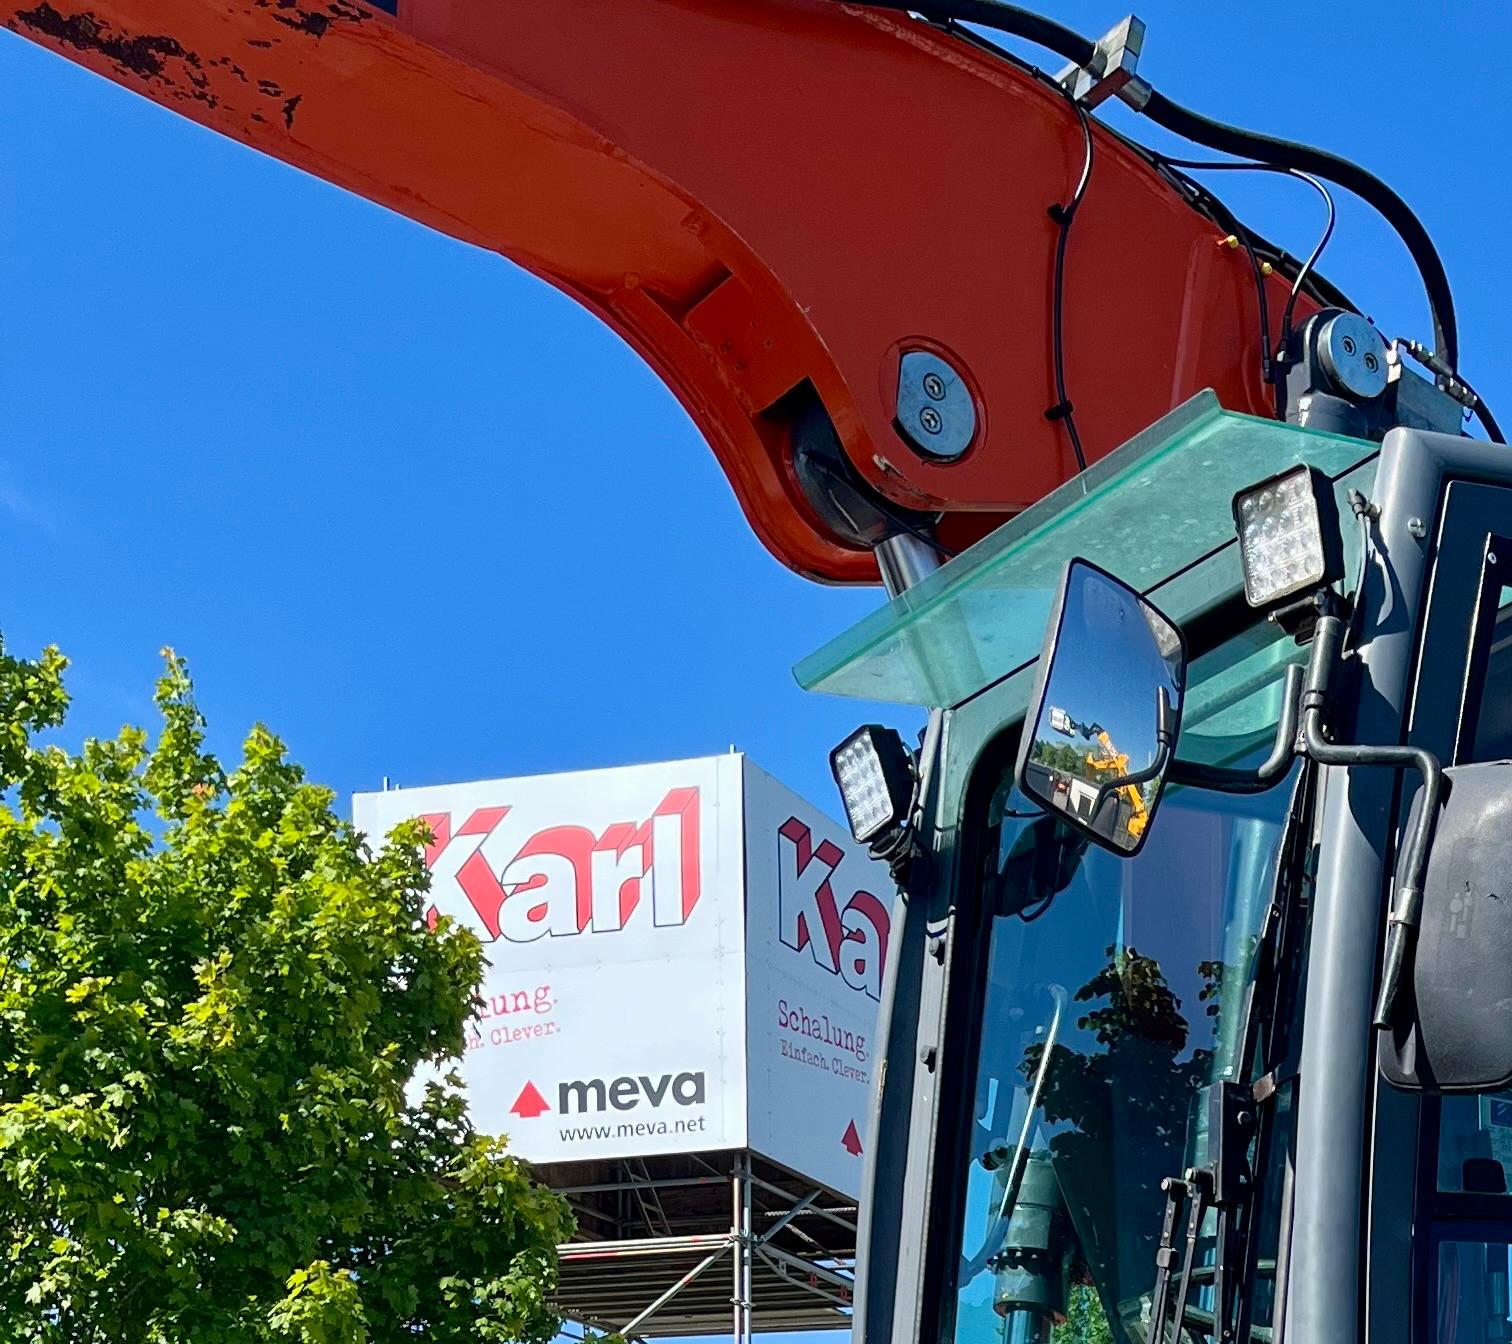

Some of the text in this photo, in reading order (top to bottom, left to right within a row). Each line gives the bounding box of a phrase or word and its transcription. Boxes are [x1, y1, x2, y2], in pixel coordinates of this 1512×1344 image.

[415, 785, 702, 944] Karl
[490, 1020, 562, 1047] Clever.
[778, 999, 870, 1063] Schalung.
[558, 1071, 706, 1115] meva
[559, 1115, 706, 1142] www.meva.net
